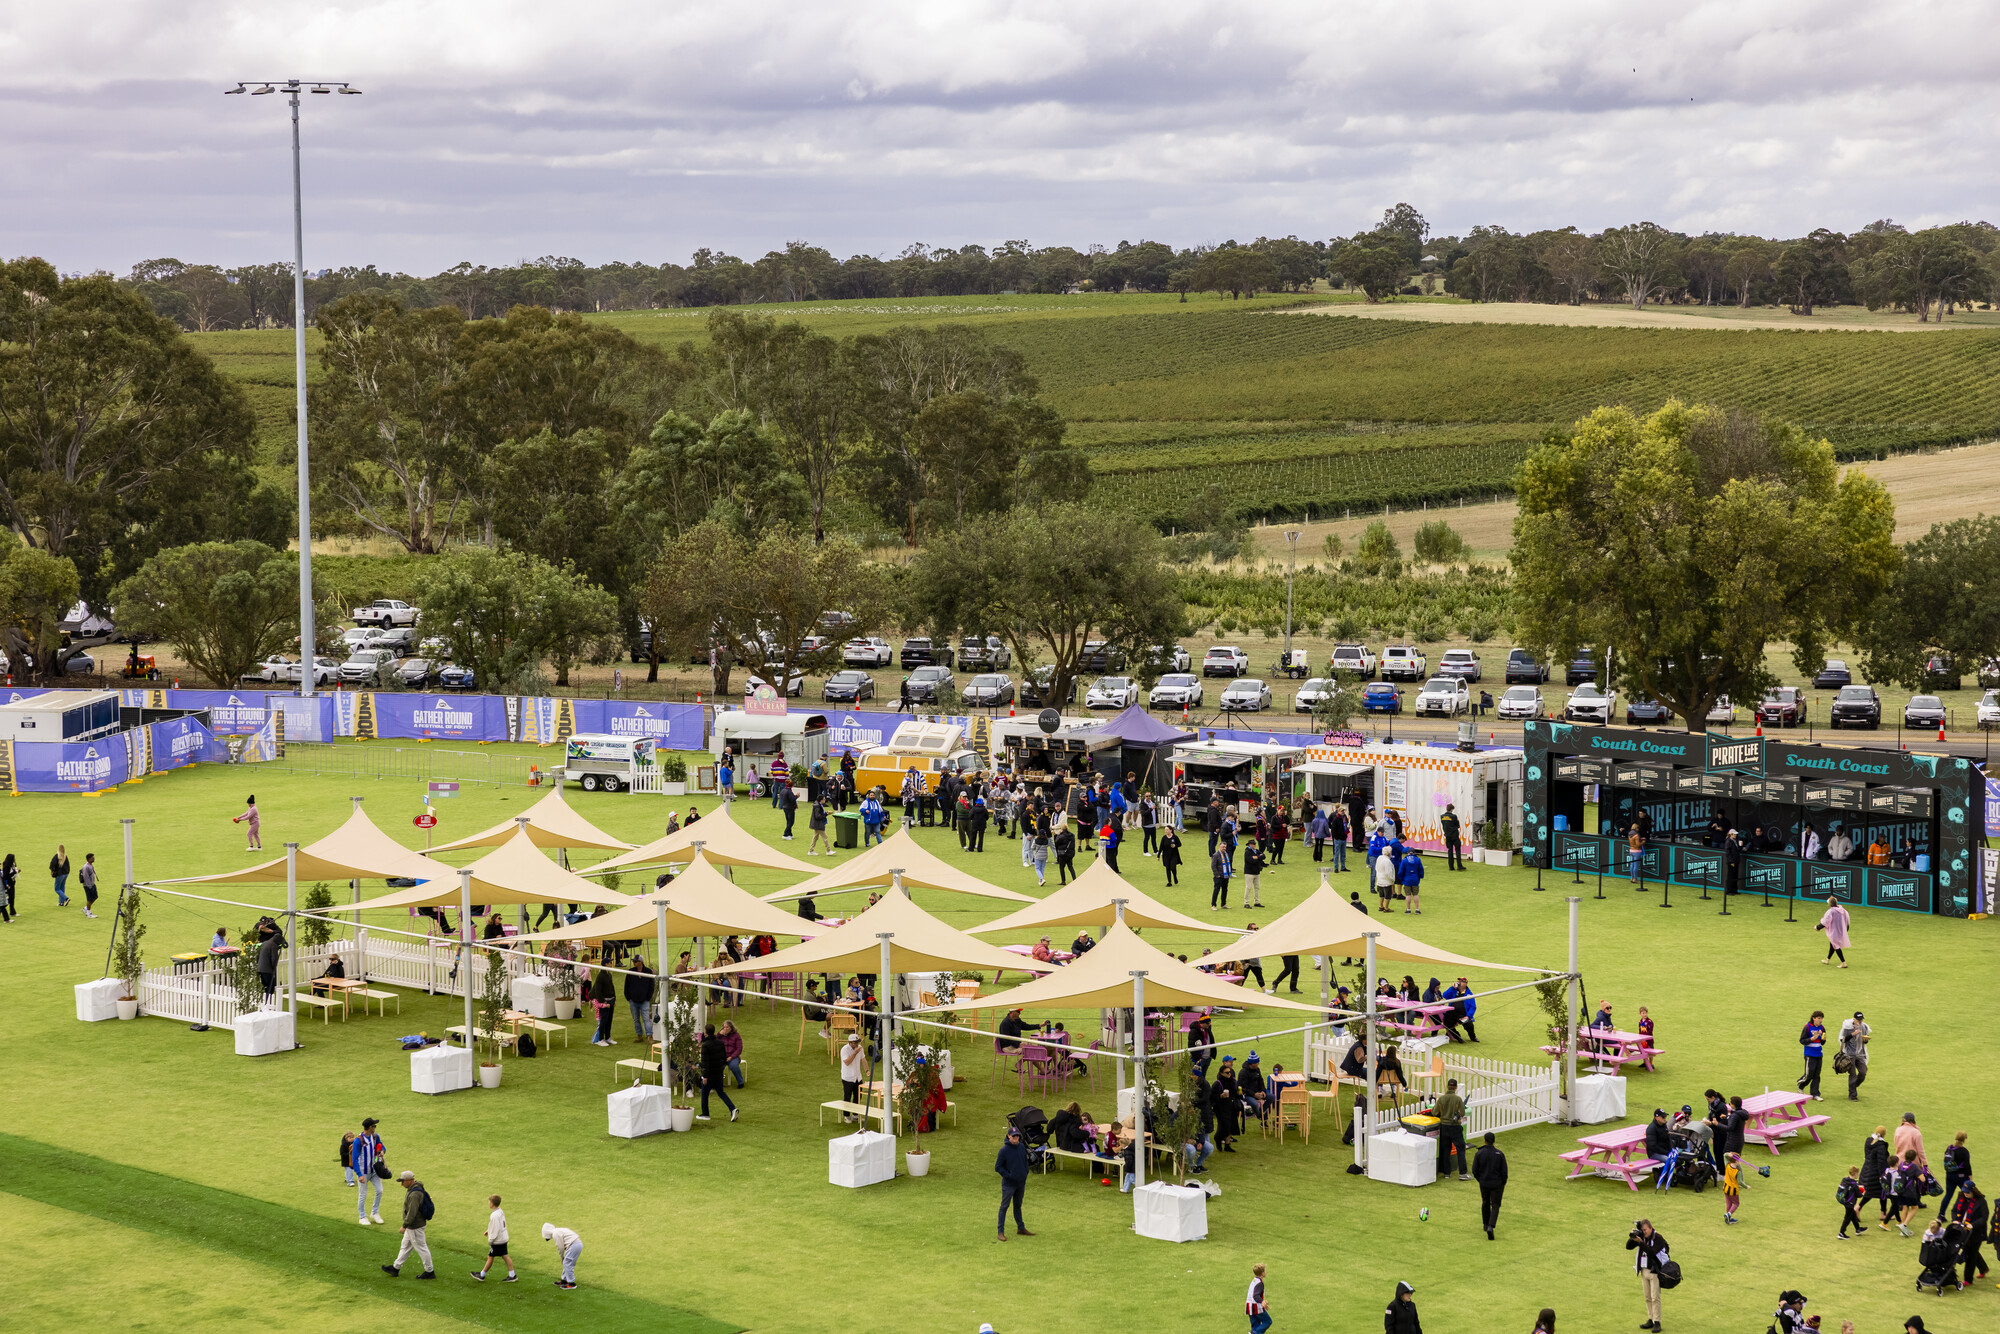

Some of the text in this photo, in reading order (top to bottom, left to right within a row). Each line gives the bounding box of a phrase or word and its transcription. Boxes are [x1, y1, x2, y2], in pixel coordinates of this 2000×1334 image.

[236, 707, 265, 720] ROUND
[356, 692, 374, 738] ROUND
[762, 702, 785, 710] CREAM
[413, 710, 472, 725] GATHER ROUND
[506, 697, 517, 742] GATHER
[522, 697, 538, 742] ROUND
[612, 717, 670, 733] GATHER ROUND
[852, 728, 882, 745] ROUND
[1591, 736, 1687, 755] South Coast
[57, 761, 95, 776] GATHER
[1786, 754, 1890, 775] South Coast
[1984, 850, 1999, 914] GATHER
